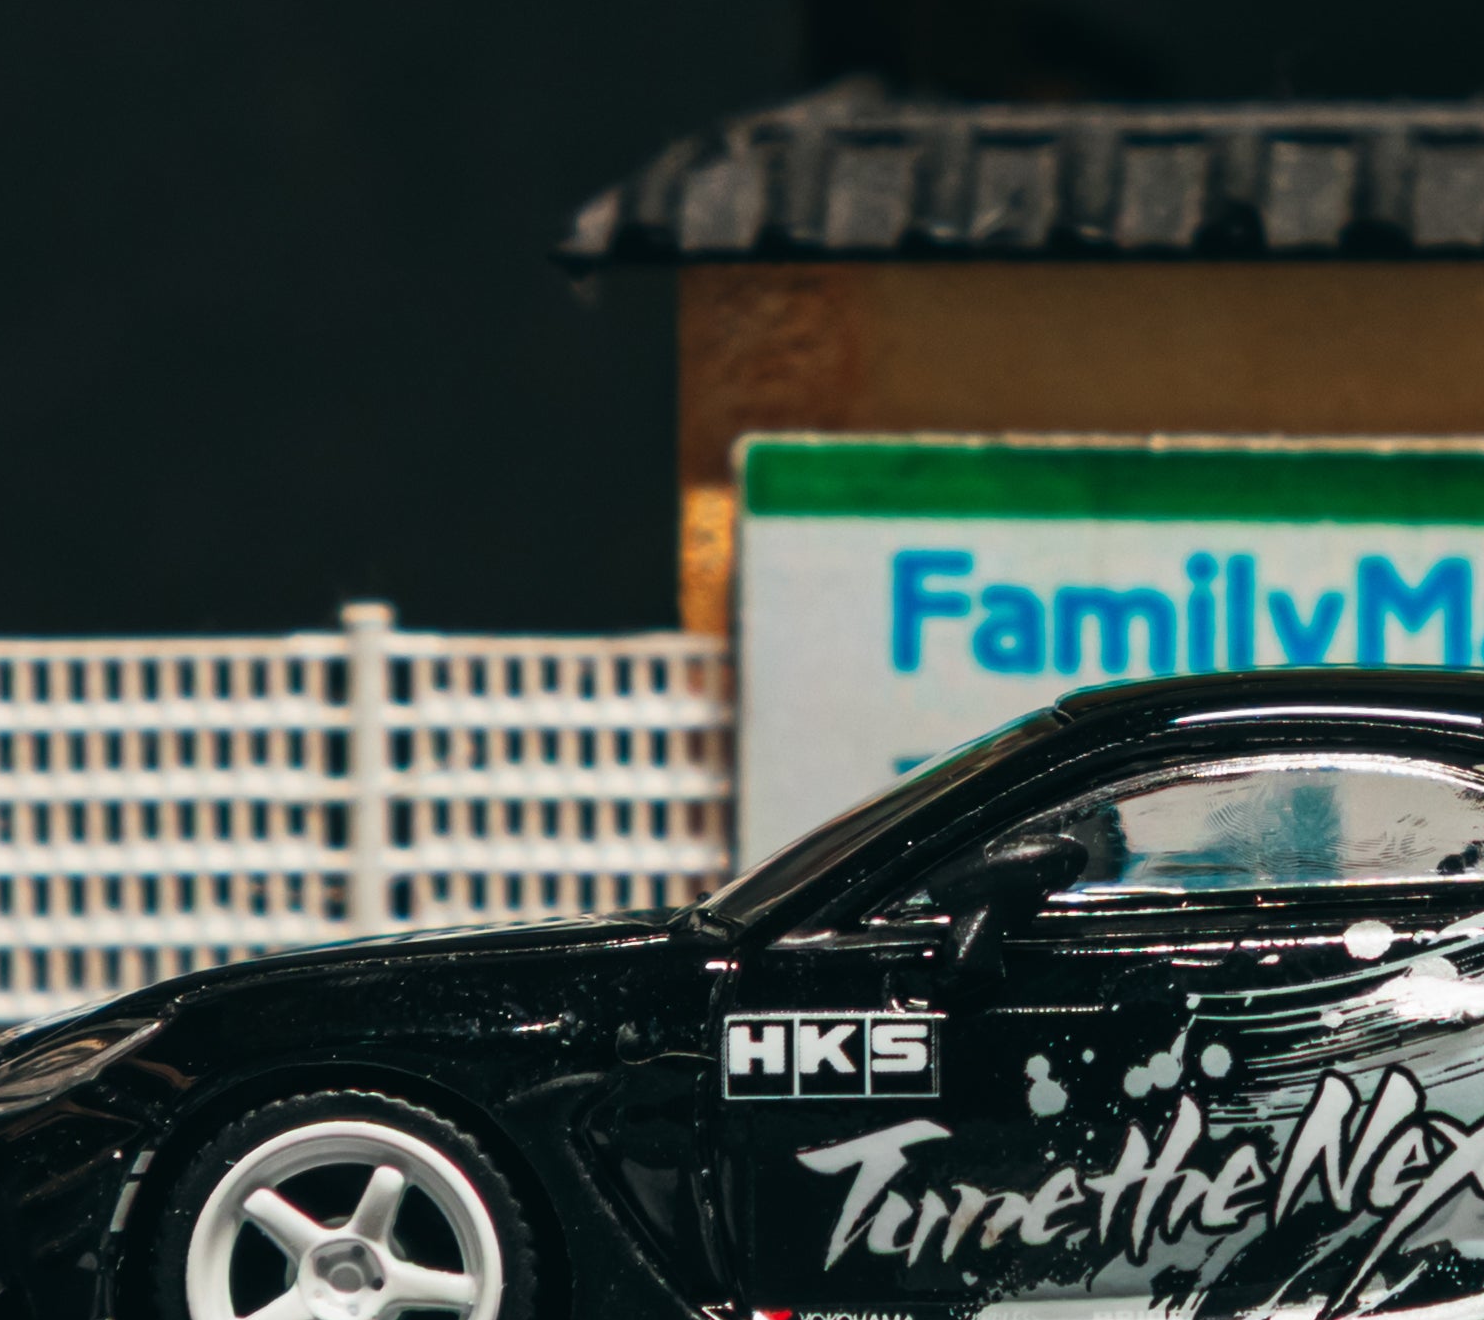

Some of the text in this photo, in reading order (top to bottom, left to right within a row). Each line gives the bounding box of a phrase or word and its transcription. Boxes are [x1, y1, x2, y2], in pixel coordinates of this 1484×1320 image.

[729, 1023, 928, 1075] HKS
[796, 1118, 1085, 1271] Tune
[1083, 1094, 1268, 1258] the
